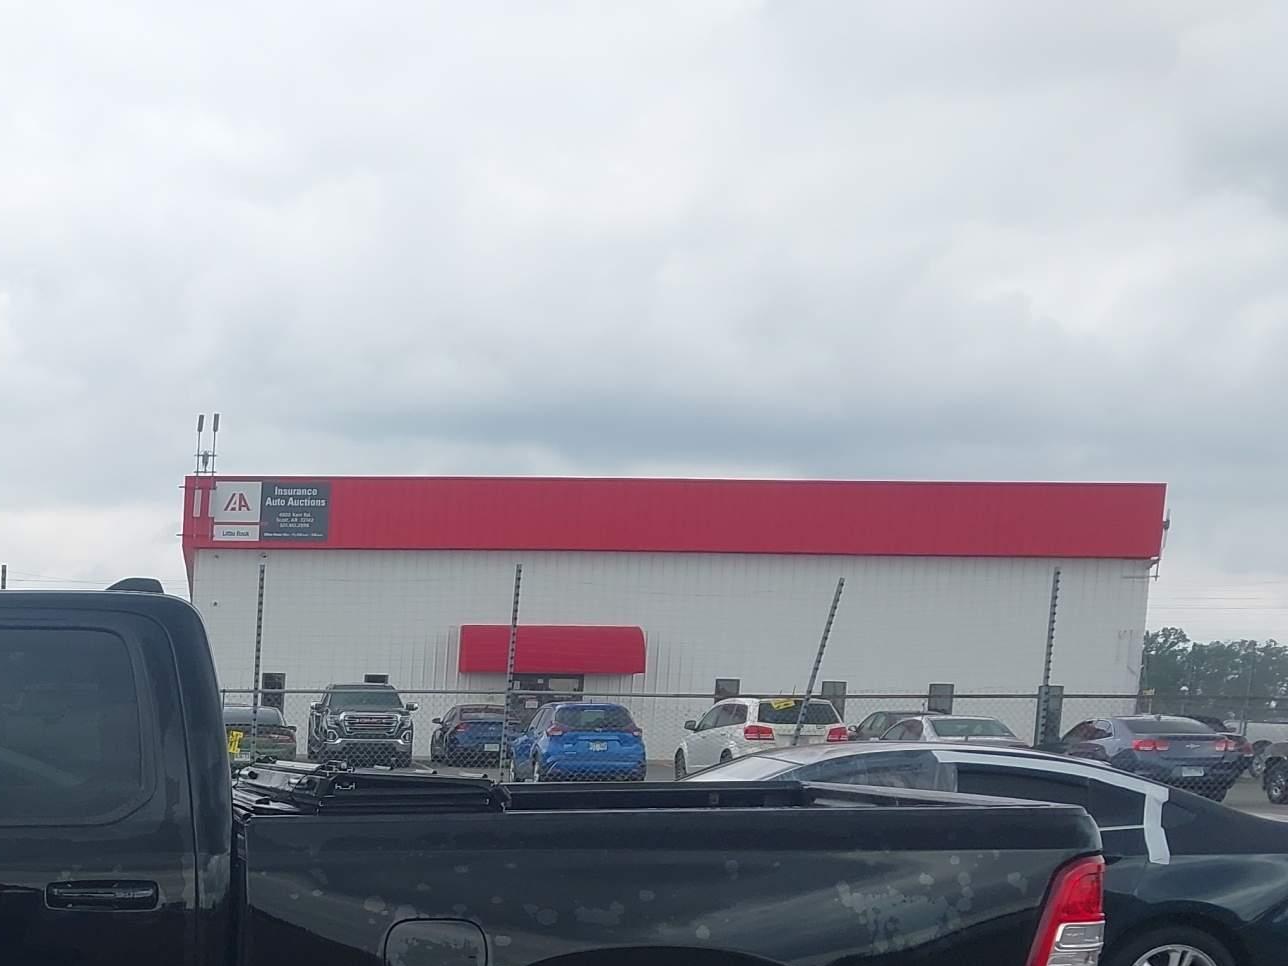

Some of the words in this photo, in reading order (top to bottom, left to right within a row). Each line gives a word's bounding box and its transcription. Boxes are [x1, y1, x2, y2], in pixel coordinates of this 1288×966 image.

[274, 486, 318, 496] Insurance
[265, 497, 286, 506] Auto
[287, 497, 326, 506] Auctions
